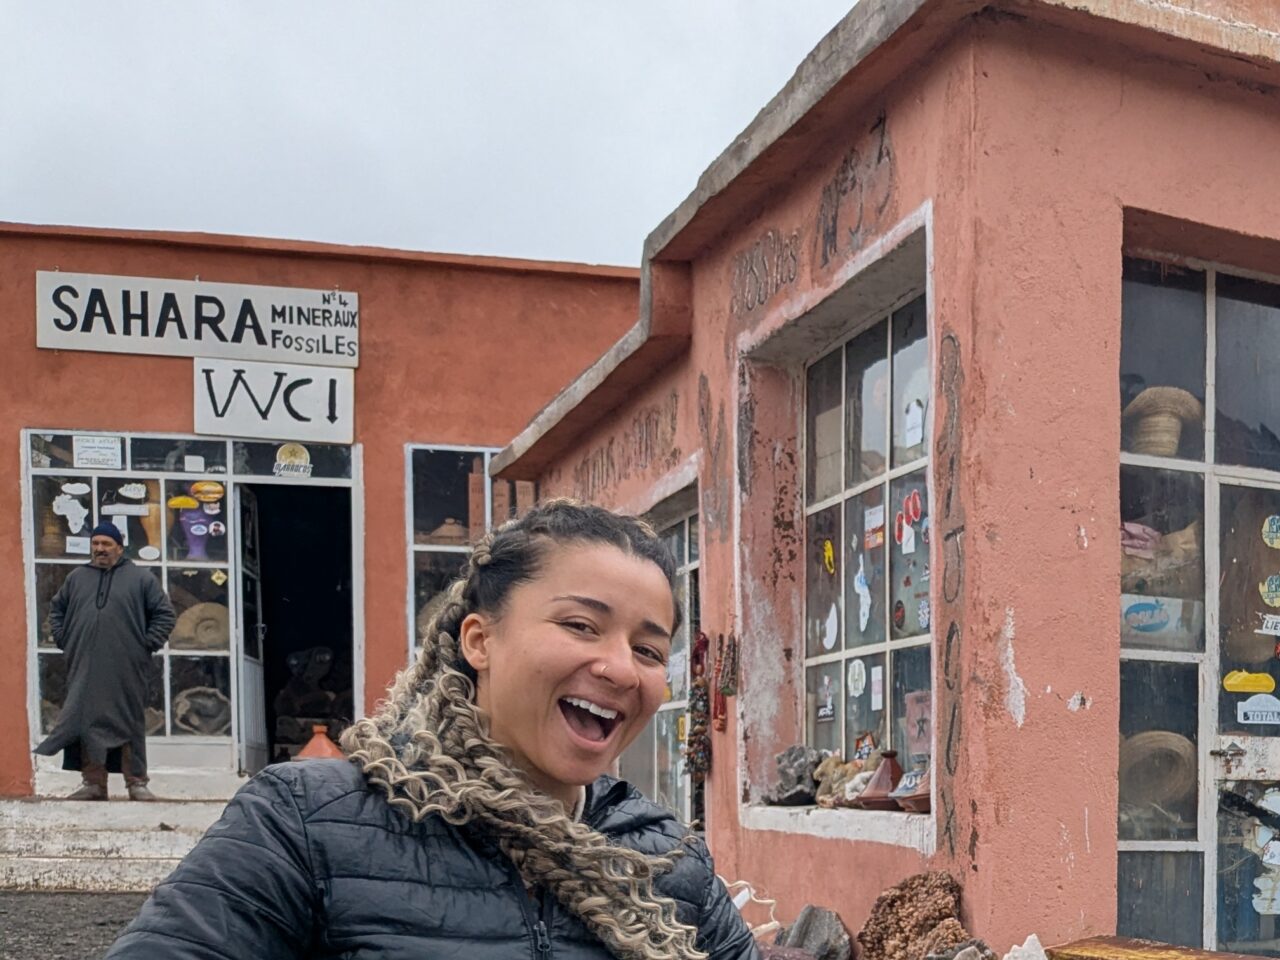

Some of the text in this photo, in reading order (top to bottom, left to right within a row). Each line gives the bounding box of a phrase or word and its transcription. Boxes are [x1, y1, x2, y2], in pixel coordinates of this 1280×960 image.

[52, 285, 267, 346] SAHARA
[271, 304, 358, 328] MINERAUX
[202, 368, 313, 422] WC
[1248, 711, 1279, 721] TOTAL
